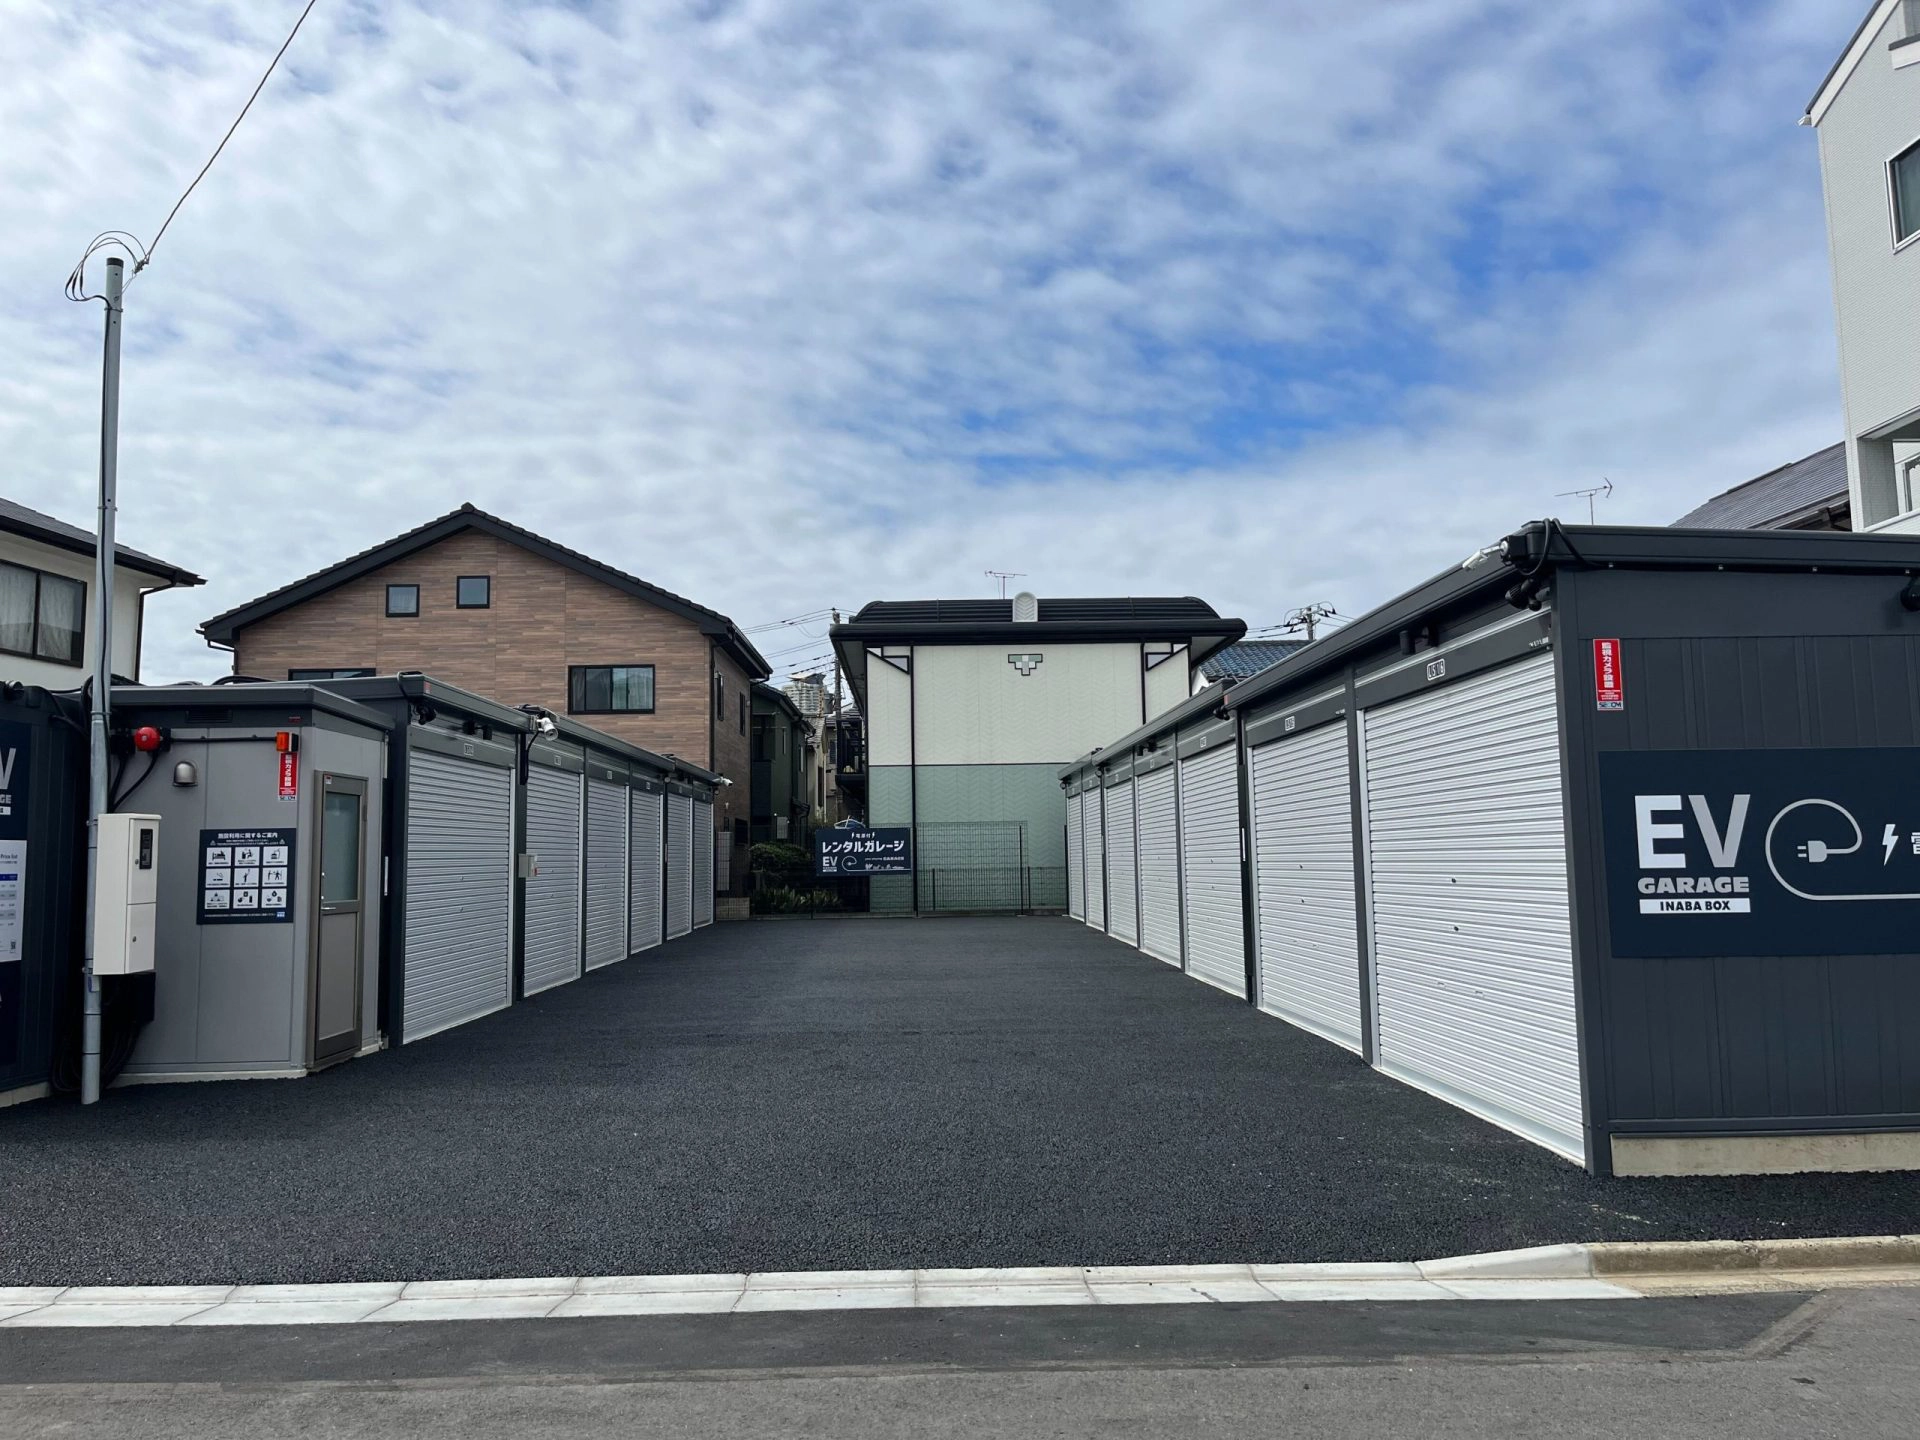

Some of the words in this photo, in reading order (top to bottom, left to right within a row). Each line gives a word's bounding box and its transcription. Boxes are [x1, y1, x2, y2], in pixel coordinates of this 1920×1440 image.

[1634, 794, 1751, 869] EV
[822, 840, 904, 853] レンタルガレージ
[822, 856, 838, 866] EV
[1637, 876, 1750, 894] GARAGE
[1660, 900, 1702, 912] INABA
[1705, 900, 1731, 912] BOX
